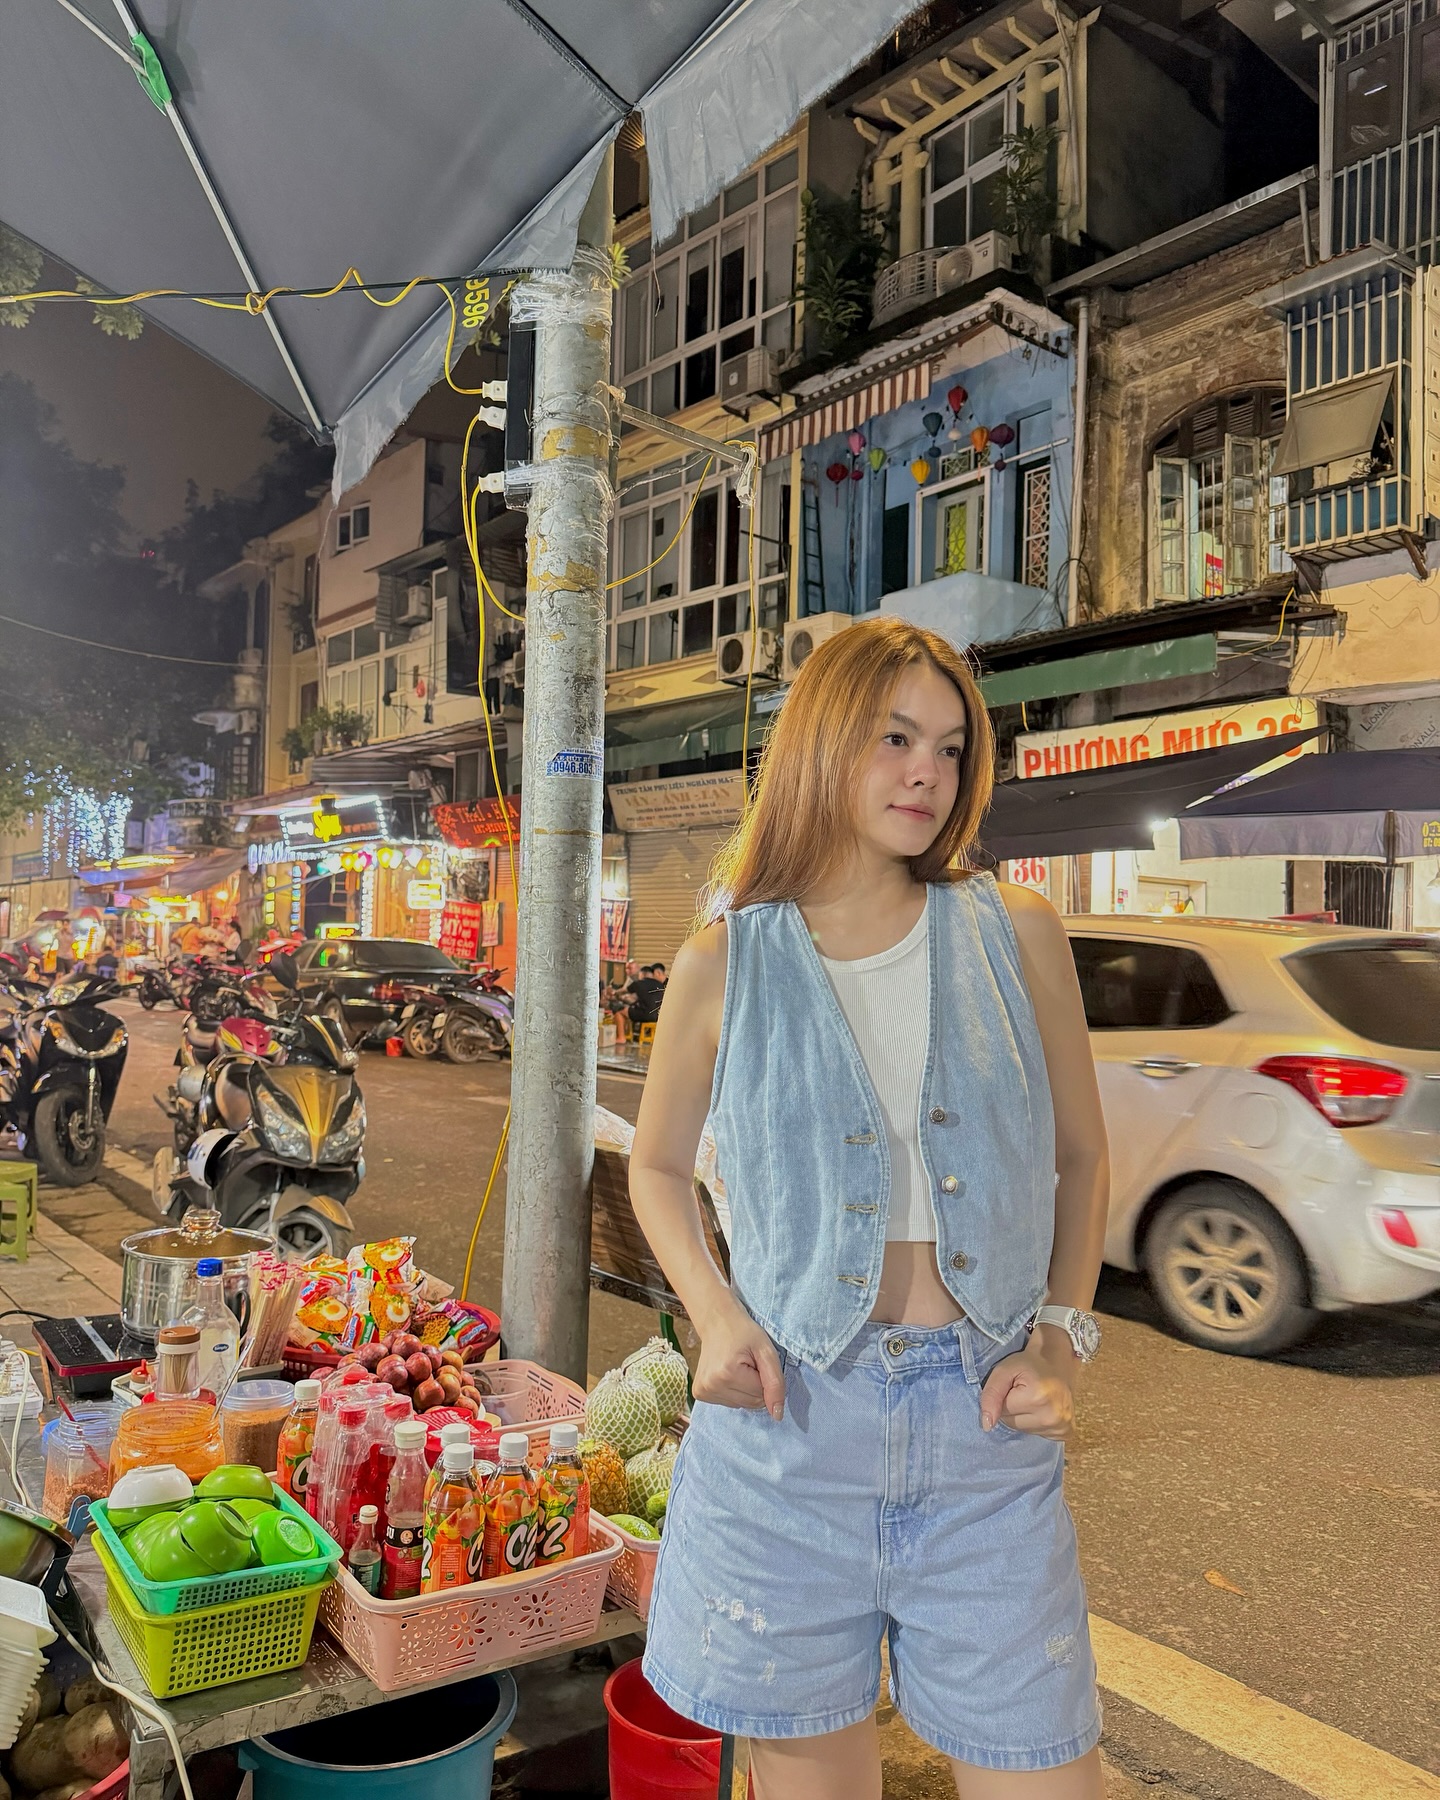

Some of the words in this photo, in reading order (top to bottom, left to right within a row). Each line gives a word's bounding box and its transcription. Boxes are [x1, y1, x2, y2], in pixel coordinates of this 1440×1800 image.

[491, 802, 519, 820] HA
[1014, 857, 1046, 884] 36
[505, 1523, 537, 1570] C2
